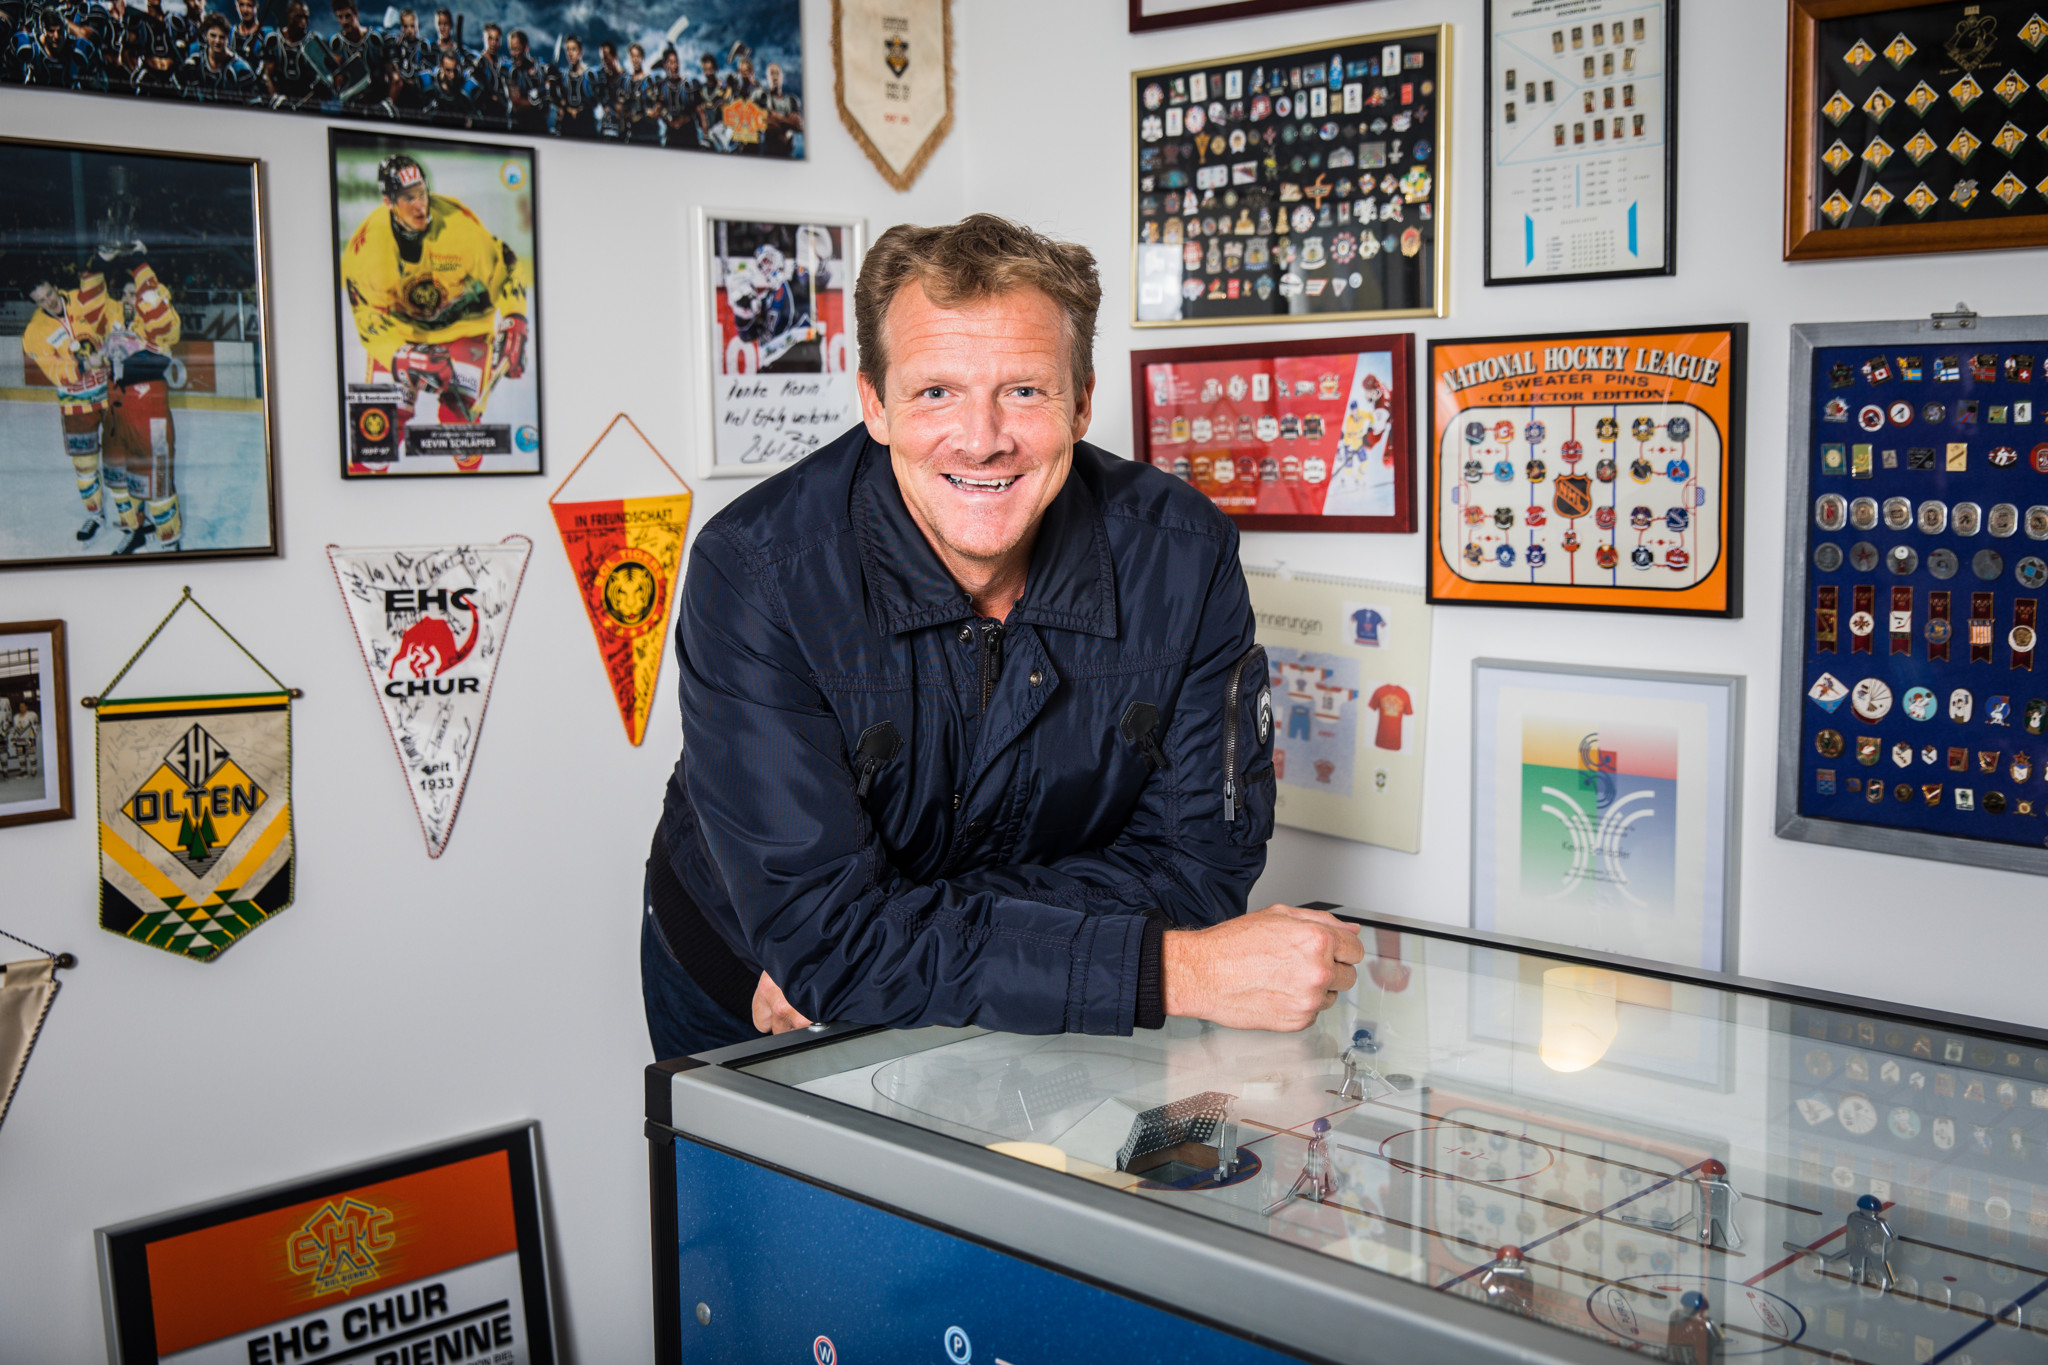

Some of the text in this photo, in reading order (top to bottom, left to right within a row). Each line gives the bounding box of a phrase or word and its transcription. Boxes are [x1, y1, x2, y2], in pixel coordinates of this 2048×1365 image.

[1442, 345, 1719, 392] NATIONAL HOCKEY LEAGUE
[1502, 374, 1650, 391] SWEATER PINS
[1487, 388, 1664, 404] COLLECTOR EDITION
[575, 507, 672, 527] IN FREUNDSCHAFT
[385, 587, 479, 612] EHC
[385, 677, 480, 698] CHUR
[420, 777, 454, 791] 1933
[133, 784, 258, 825] OLTEN
[288, 1207, 395, 1274] EHC
[248, 1282, 448, 1365] EHC CHUR
